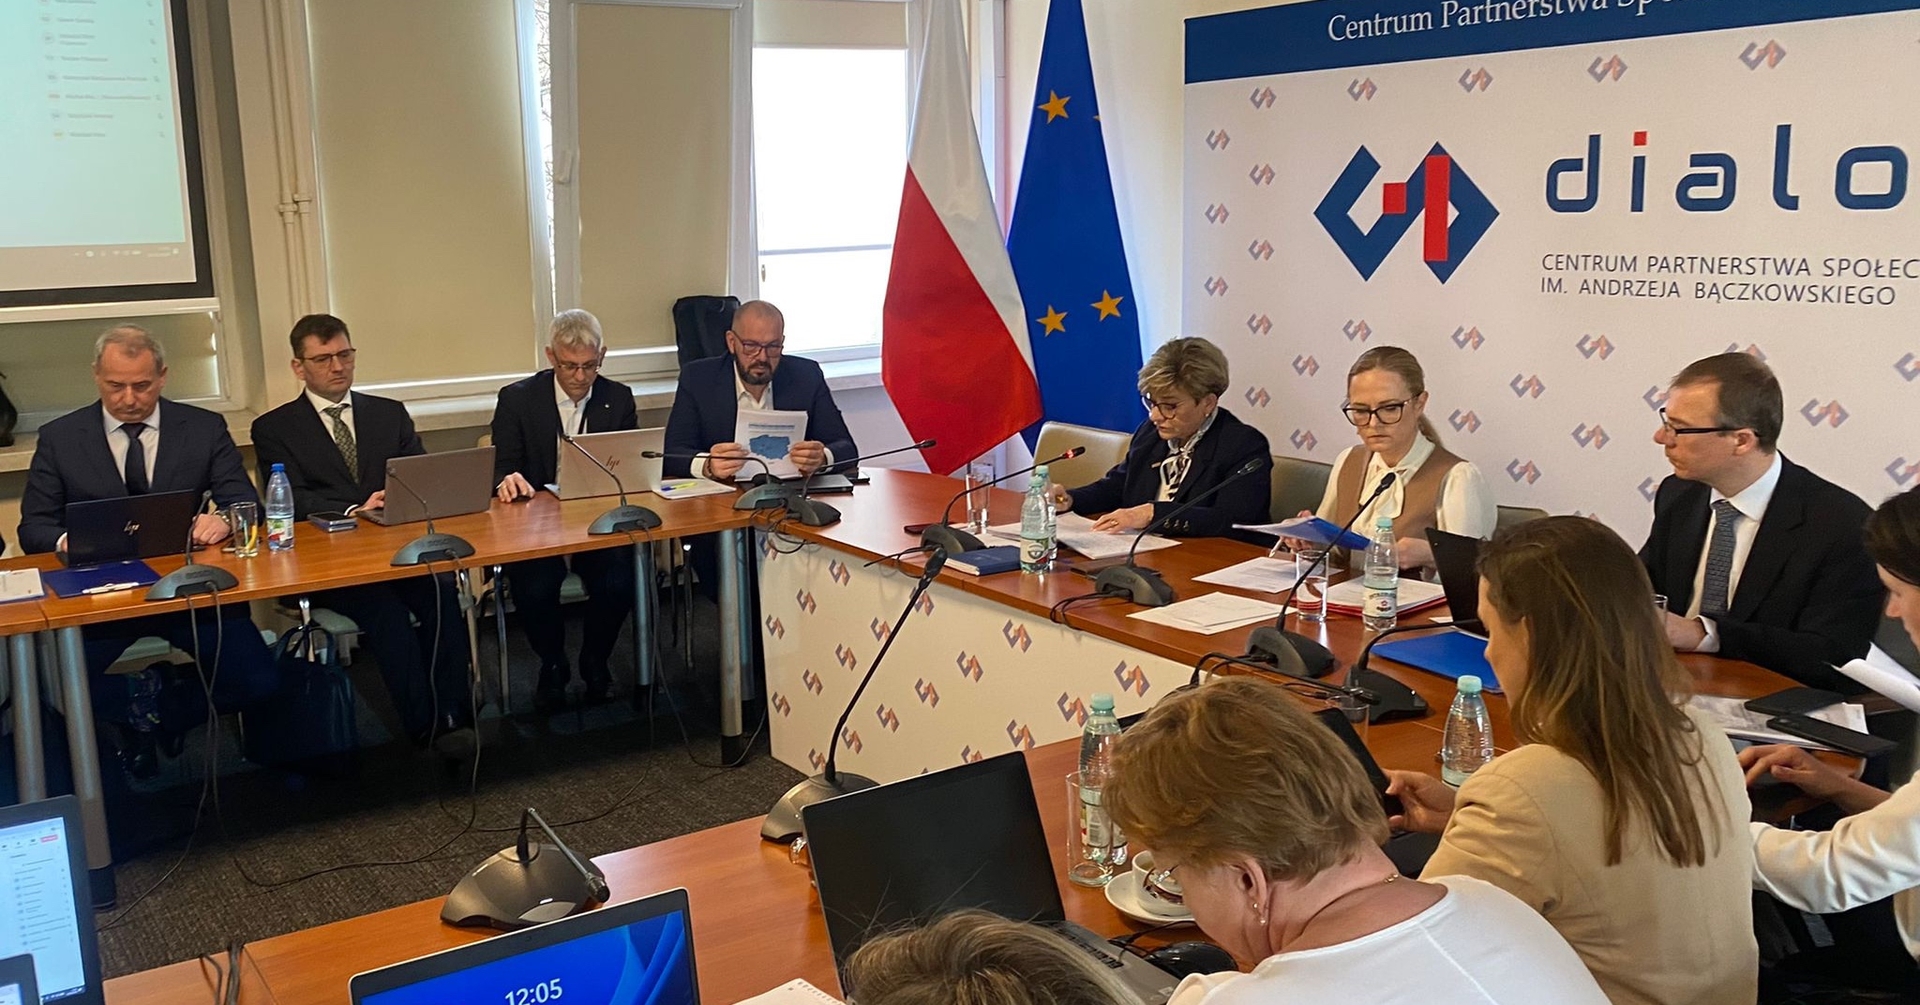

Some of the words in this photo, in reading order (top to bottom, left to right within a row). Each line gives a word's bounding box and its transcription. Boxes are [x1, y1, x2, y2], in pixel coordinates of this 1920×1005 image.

[1328, 13, 1434, 41] Centrum
[1546, 124, 1908, 213] dialo
[1542, 254, 1637, 273] CENTRUM
[1647, 256, 1811, 276] PARTNERSTWA
[1823, 258, 1920, 279] SPOŁEC
[1541, 277, 1568, 294] IM.
[1579, 279, 1681, 298] ANDRZEJA
[1695, 282, 1896, 305] BĄCZKOWSKIEGO
[505, 978, 562, 1005] 12:05
